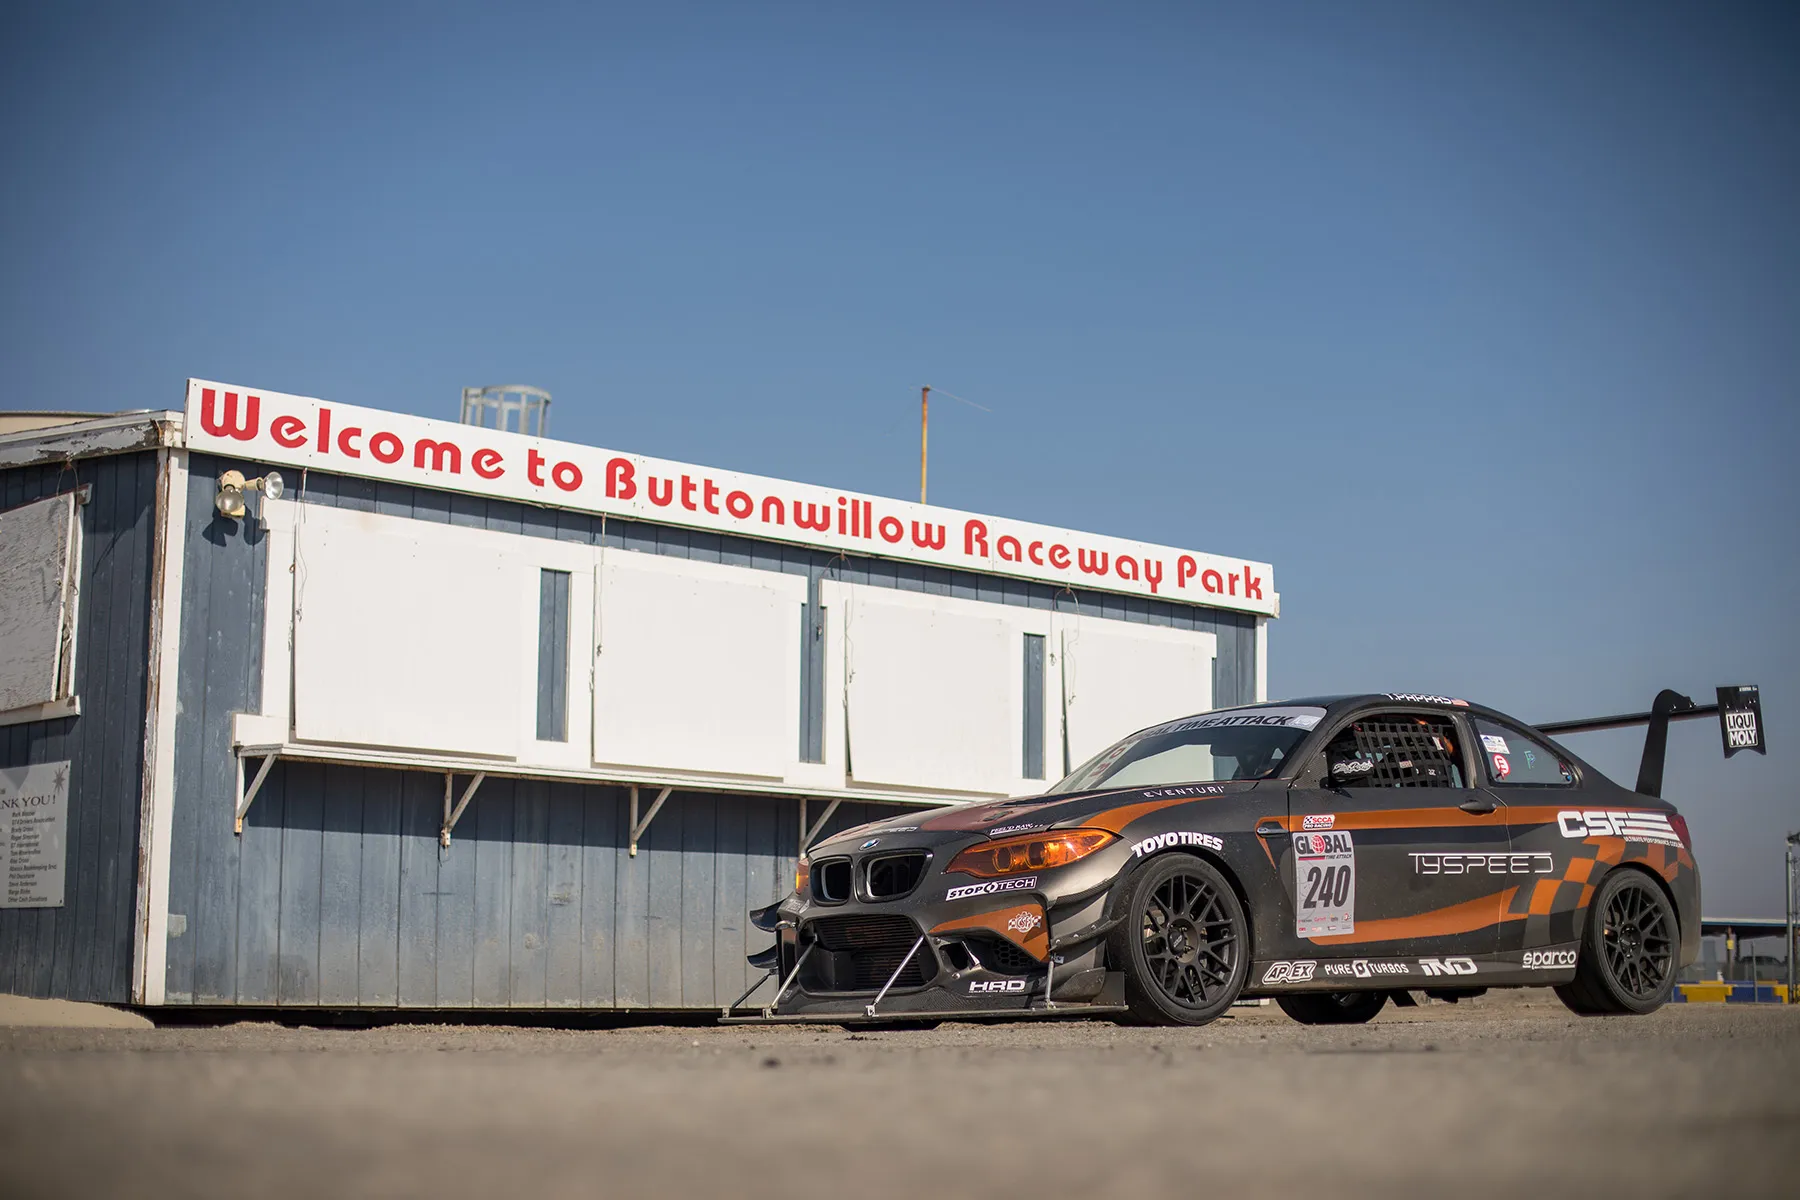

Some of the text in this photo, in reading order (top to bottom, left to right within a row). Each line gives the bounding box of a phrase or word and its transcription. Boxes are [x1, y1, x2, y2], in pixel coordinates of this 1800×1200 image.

[200, 388, 1262, 600] Welcome to Buttonwillow Raceway Park
[1214, 715, 1294, 726] ATTACK
[1727, 713, 1755, 729] LIQUI
[1729, 730, 1757, 746] MOLY
[1143, 786, 1224, 798] EVENTURI
[1557, 811, 1632, 838] CSF
[1130, 831, 1224, 858] TOYO TIRES
[1295, 834, 1352, 855] GLOBAL
[1408, 853, 1554, 875] TYSPEED
[1303, 865, 1351, 910] 240
[1324, 963, 1410, 976] PURE TURBOS
[1522, 951, 1577, 970] sparco
[969, 980, 1026, 991] HRD
